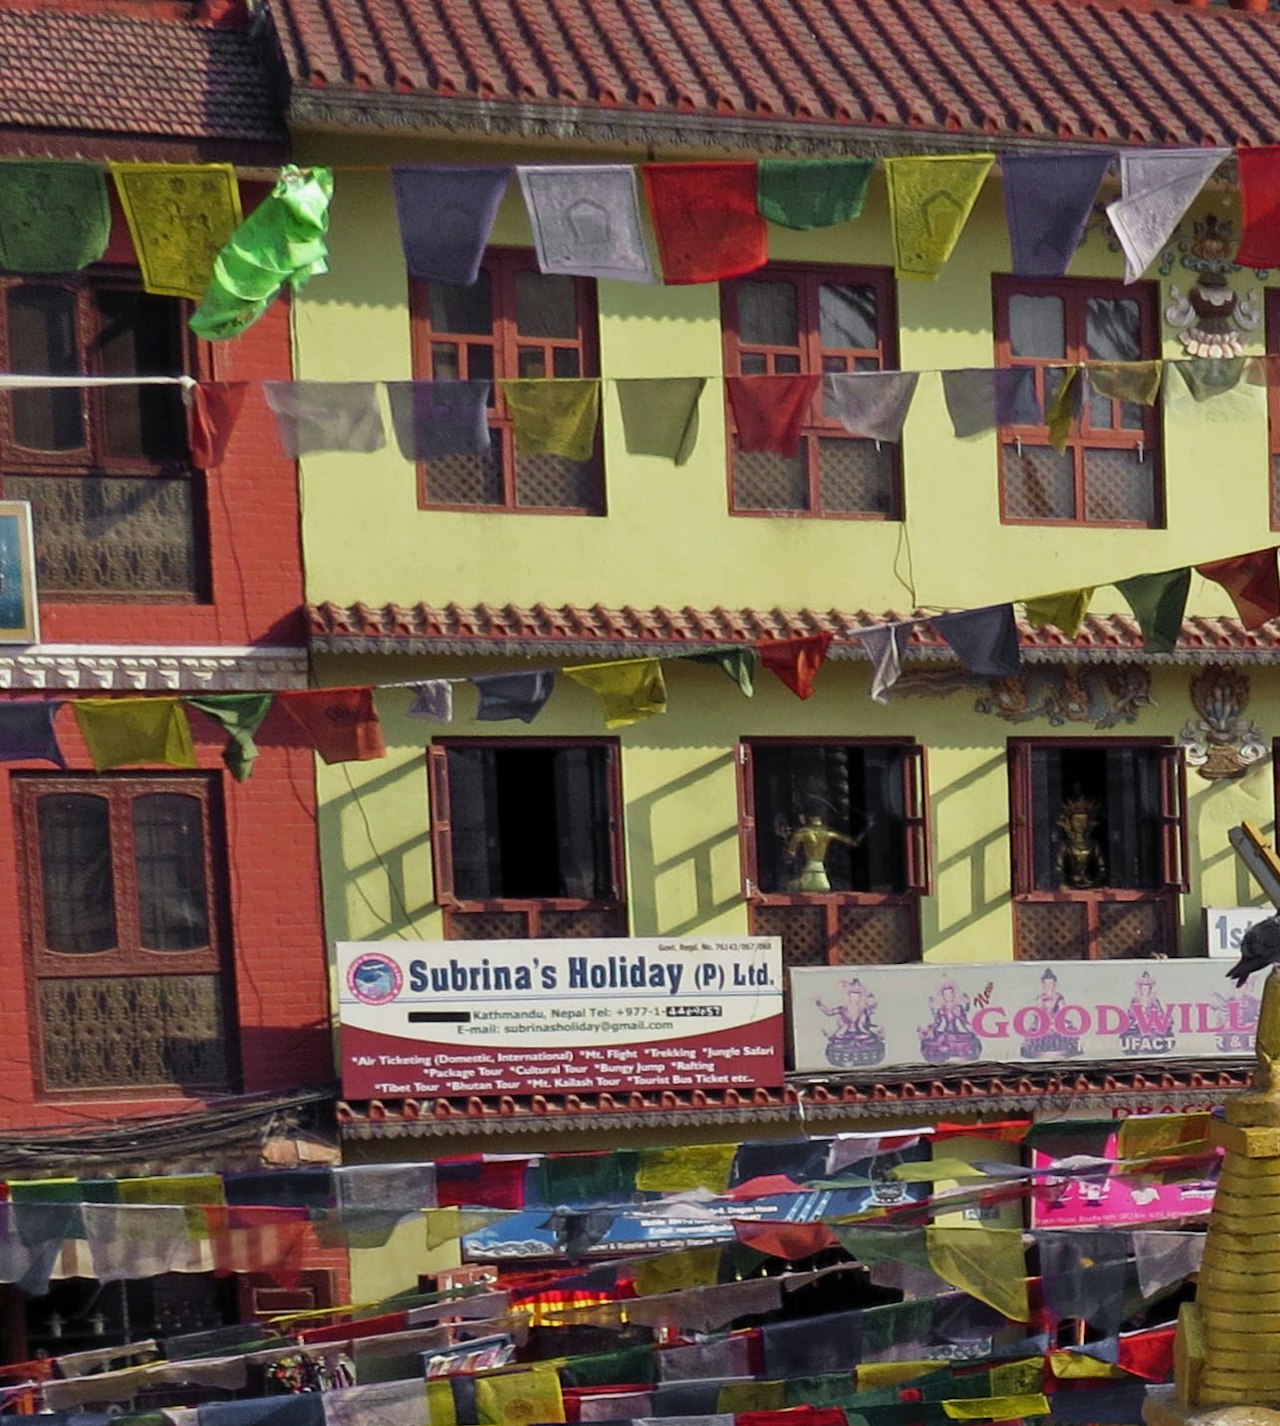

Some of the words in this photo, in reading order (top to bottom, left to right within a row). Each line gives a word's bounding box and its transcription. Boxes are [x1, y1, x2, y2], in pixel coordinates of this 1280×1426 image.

[409, 957, 558, 993] Subrina's
[568, 956, 684, 995] Holiday
[694, 963, 725, 990] (P)
[733, 962, 775, 986] Ltd.
[552, 1008, 586, 1020] Nepal
[588, 1007, 611, 1018] Tel:
[972, 1001, 1259, 1039] GOODWILL
[457, 1023, 500, 1035] E-mail:
[504, 1020, 674, 1034] subrinasholiday@gmail.com
[379, 1055, 432, 1067] Ticketing
[497, 1051, 574, 1063] International)
[606, 1049, 638, 1061] Flight
[742, 1046, 774, 1056] Safari
[478, 1067, 504, 1077] Tour
[564, 1064, 588, 1074] Tour
[636, 1062, 665, 1074] Jump
[413, 1082, 440, 1092] Tour
[495, 1080, 521, 1090] Tour
[554, 1077, 594, 1088] Kailash
[597, 1077, 621, 1087] Tour
[673, 1075, 693, 1084] Bus
[696, 1074, 730, 1084] Ticket
